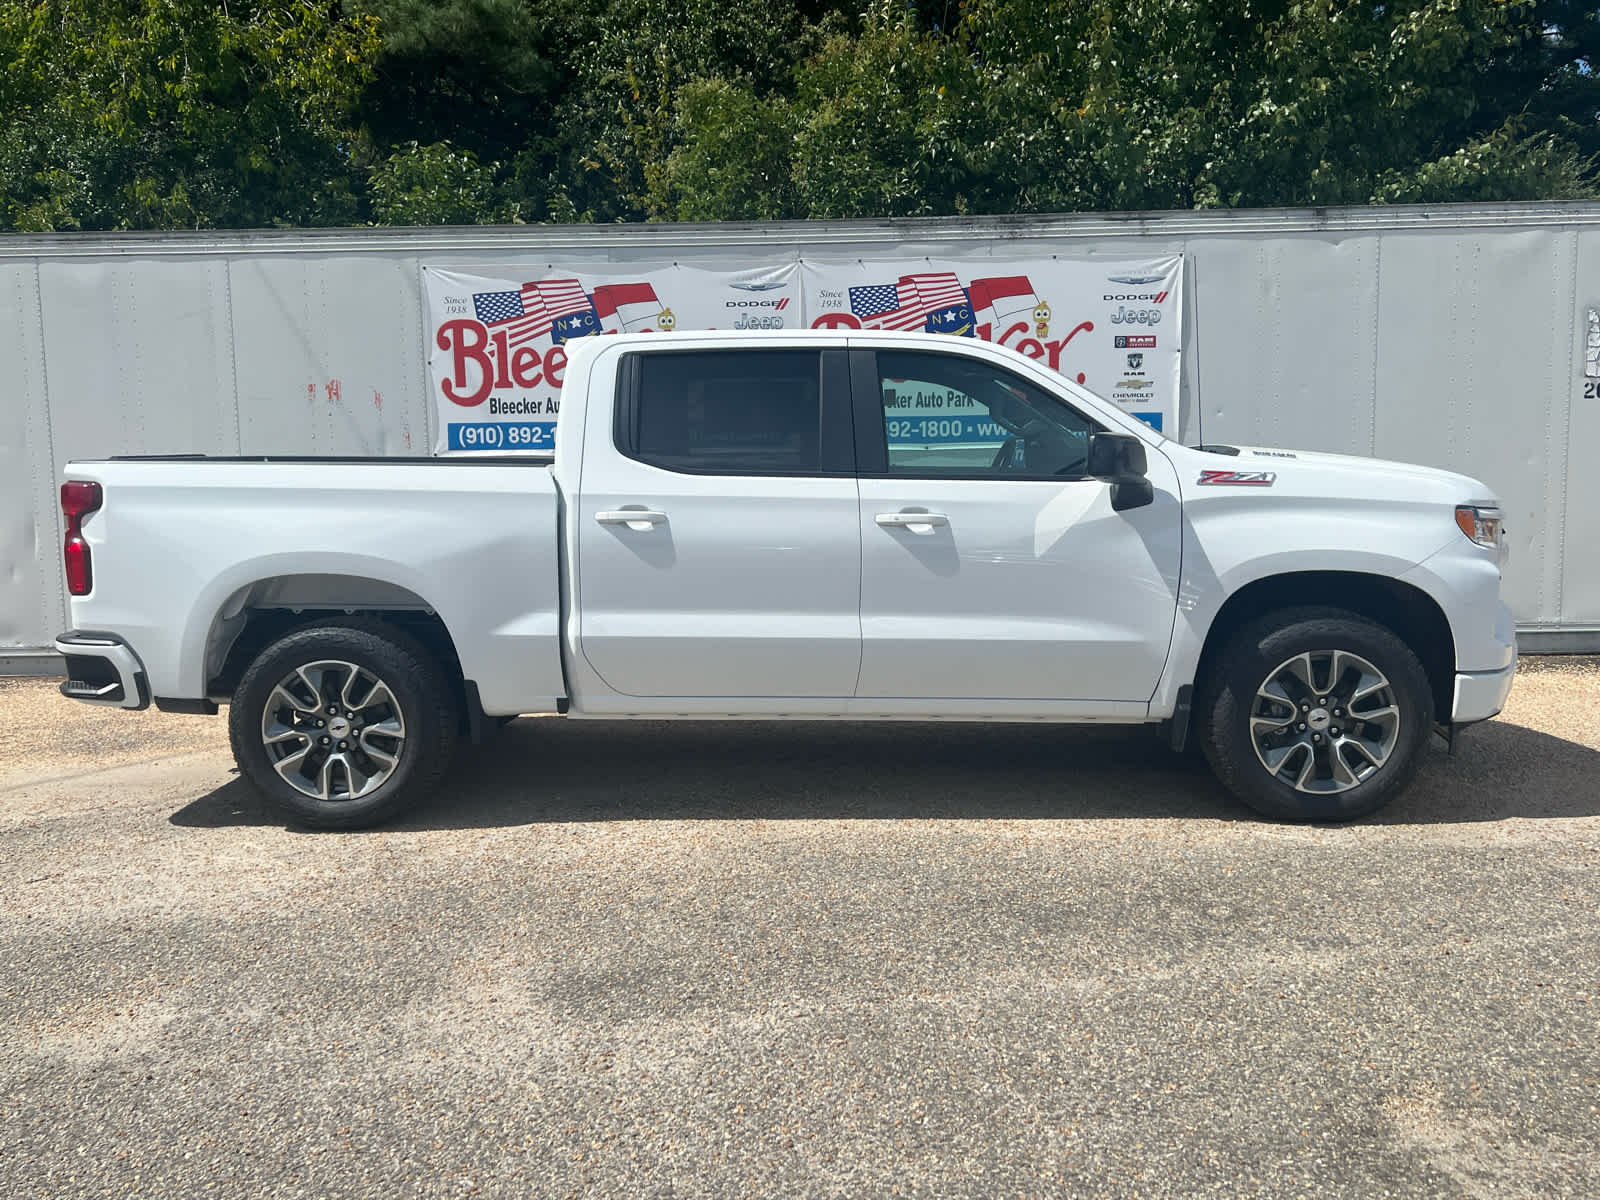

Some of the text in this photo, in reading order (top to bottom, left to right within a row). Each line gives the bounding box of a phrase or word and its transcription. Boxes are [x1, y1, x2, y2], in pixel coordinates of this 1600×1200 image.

[443, 296, 468, 305] Since
[819, 289, 843, 298] Since
[445, 305, 468, 314] 1938
[725, 300, 781, 308] DODGE
[820, 299, 843, 308] 1938
[557, 315, 595, 331] N C
[734, 312, 784, 329] Jeep
[931, 309, 969, 325] N C
[1111, 305, 1161, 327] Jeep
[489, 397, 542, 414] Bleecker
[915, 391, 943, 409] Auto
[946, 390, 975, 408] Park
[459, 425, 504, 448] (910)
[887, 420, 962, 438] 92-1800
[1199, 470, 1275, 486] Z71
